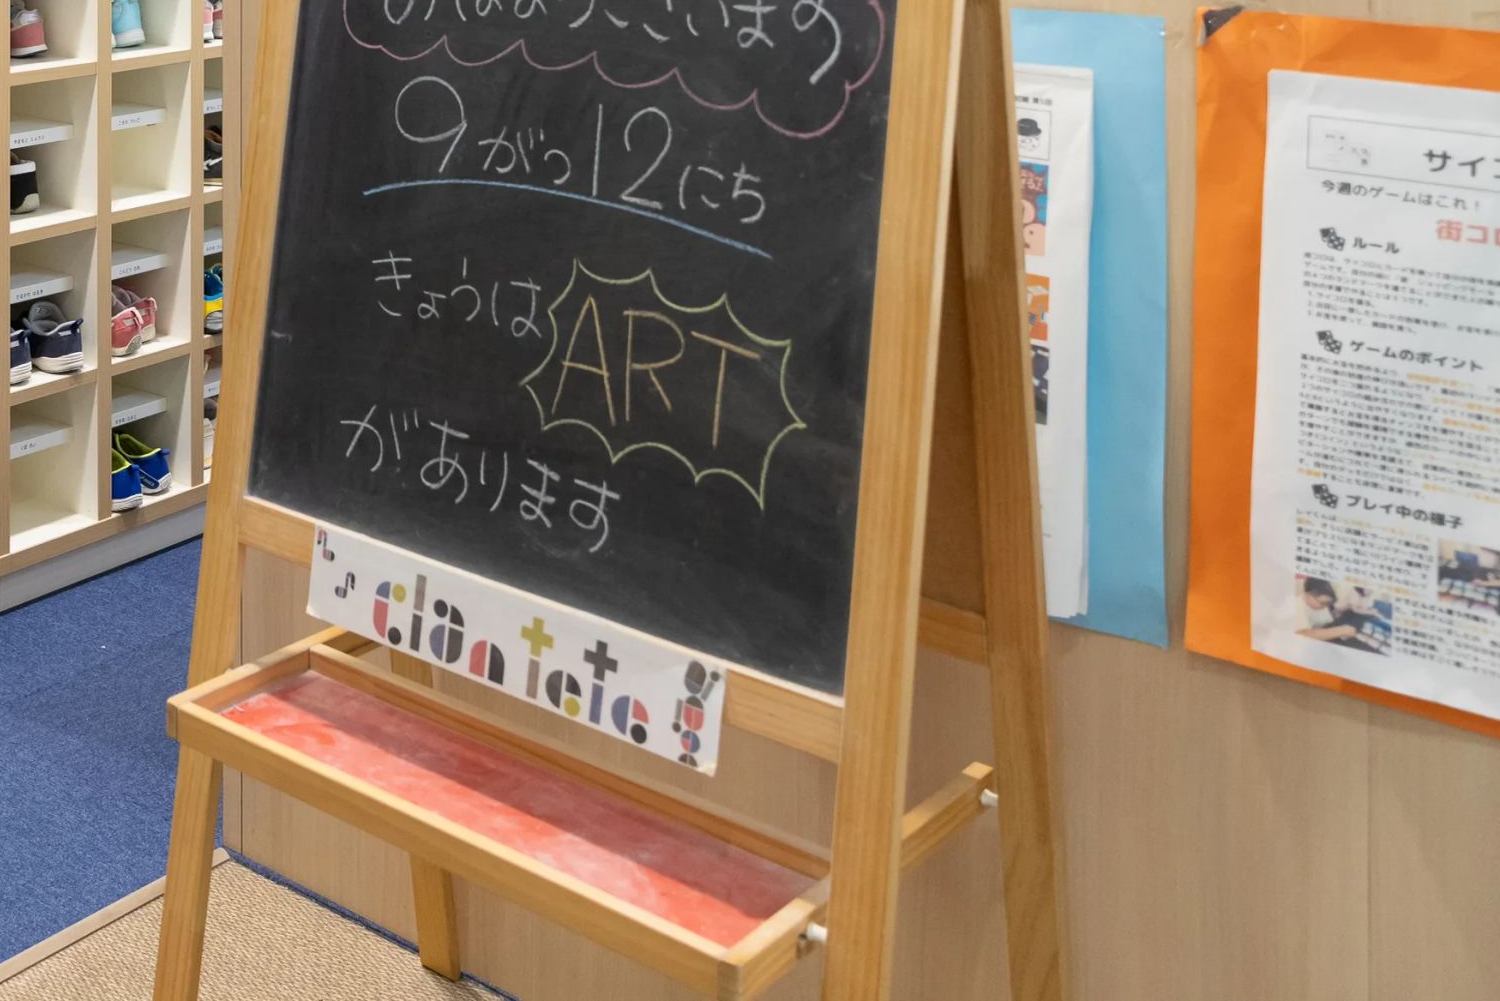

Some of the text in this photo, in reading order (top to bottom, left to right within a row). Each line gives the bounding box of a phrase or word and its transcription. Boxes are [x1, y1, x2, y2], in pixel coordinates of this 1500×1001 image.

[1423, 148, 1500, 179] サイ
[1352, 236, 1400, 255] ルール
[372, 250, 762, 450] きょうは ART
[1349, 339, 1484, 372] ゲームのポイント
[340, 404, 620, 554] があります
